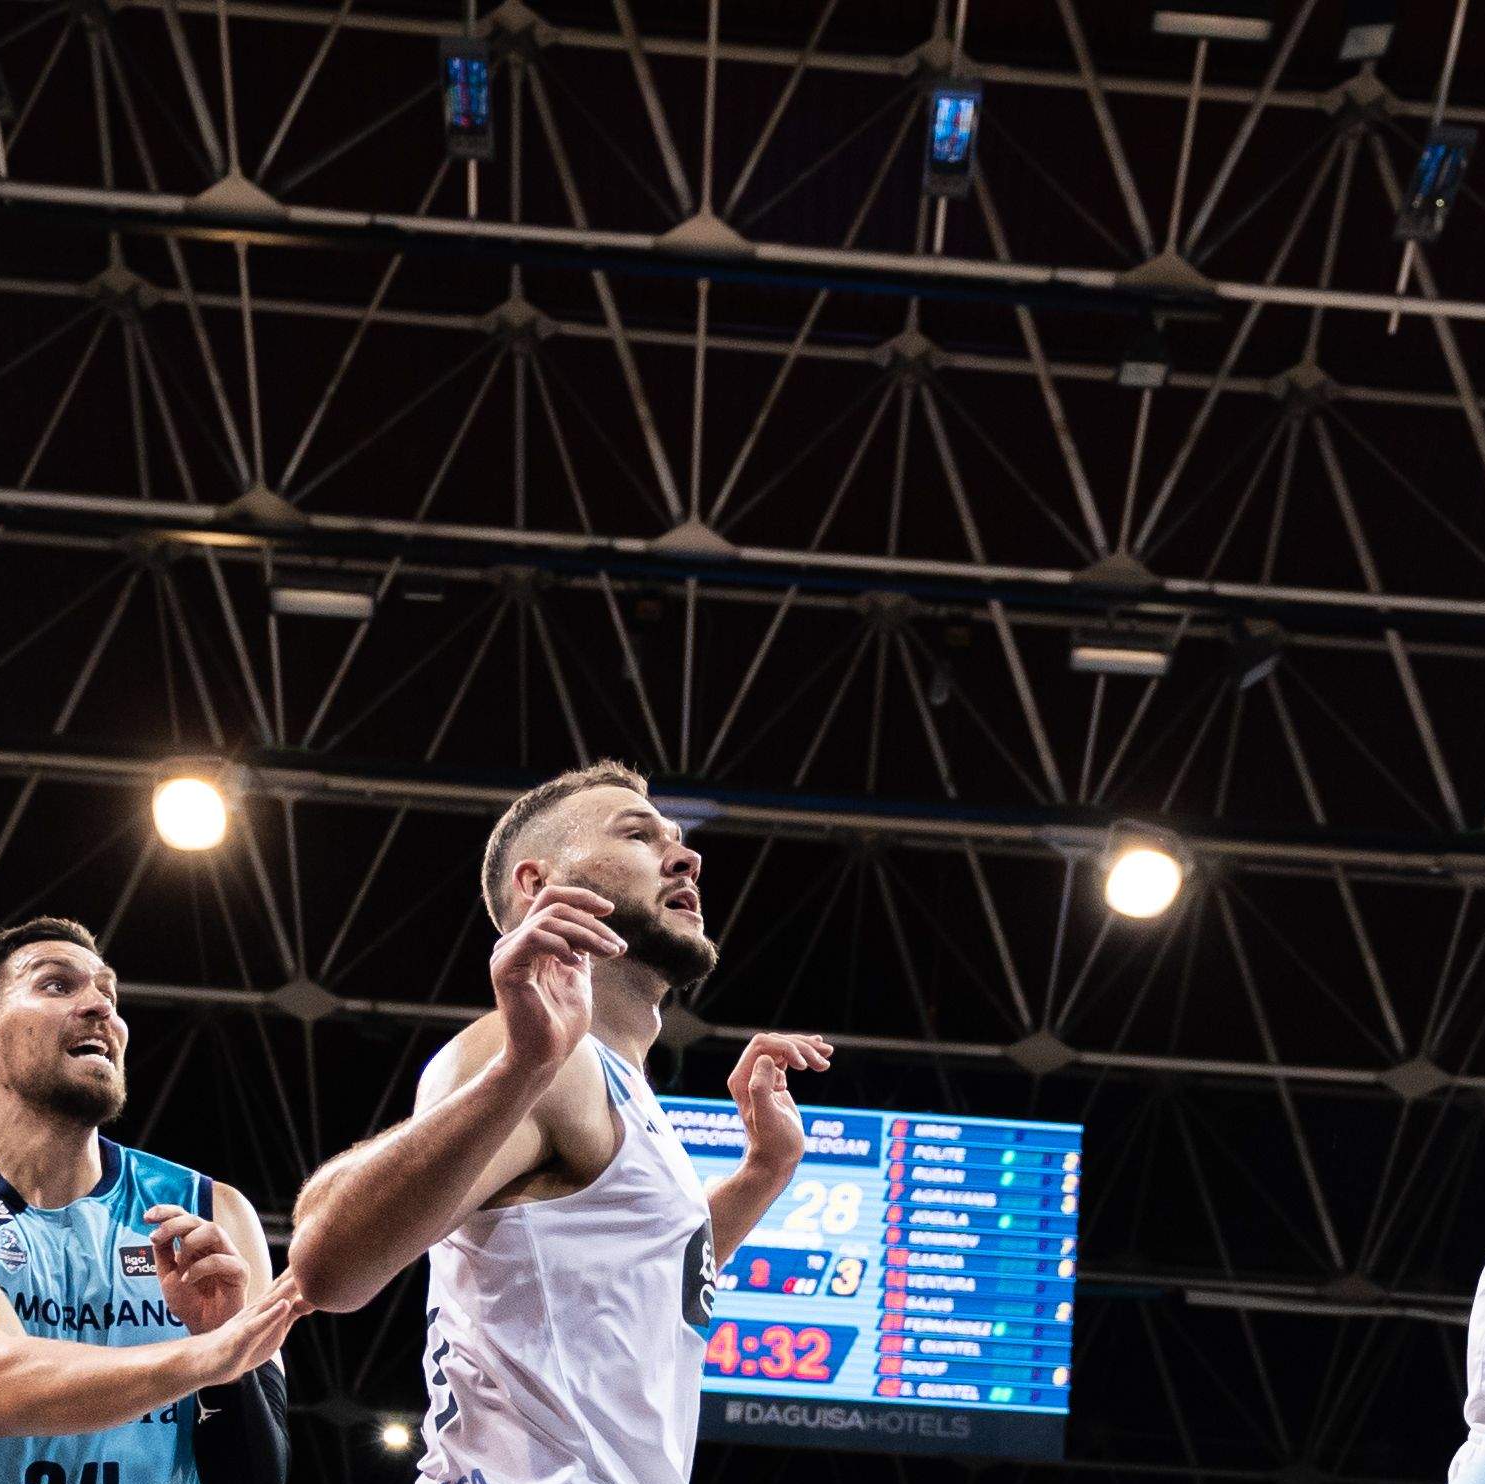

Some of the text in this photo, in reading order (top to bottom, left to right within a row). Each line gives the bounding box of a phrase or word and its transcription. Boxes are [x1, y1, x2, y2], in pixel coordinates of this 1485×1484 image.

[783, 1179, 863, 1235] 28
[125, 1261, 157, 1275] ende
[831, 1257, 863, 1296] 3
[705, 1320, 832, 1380] 4:32
